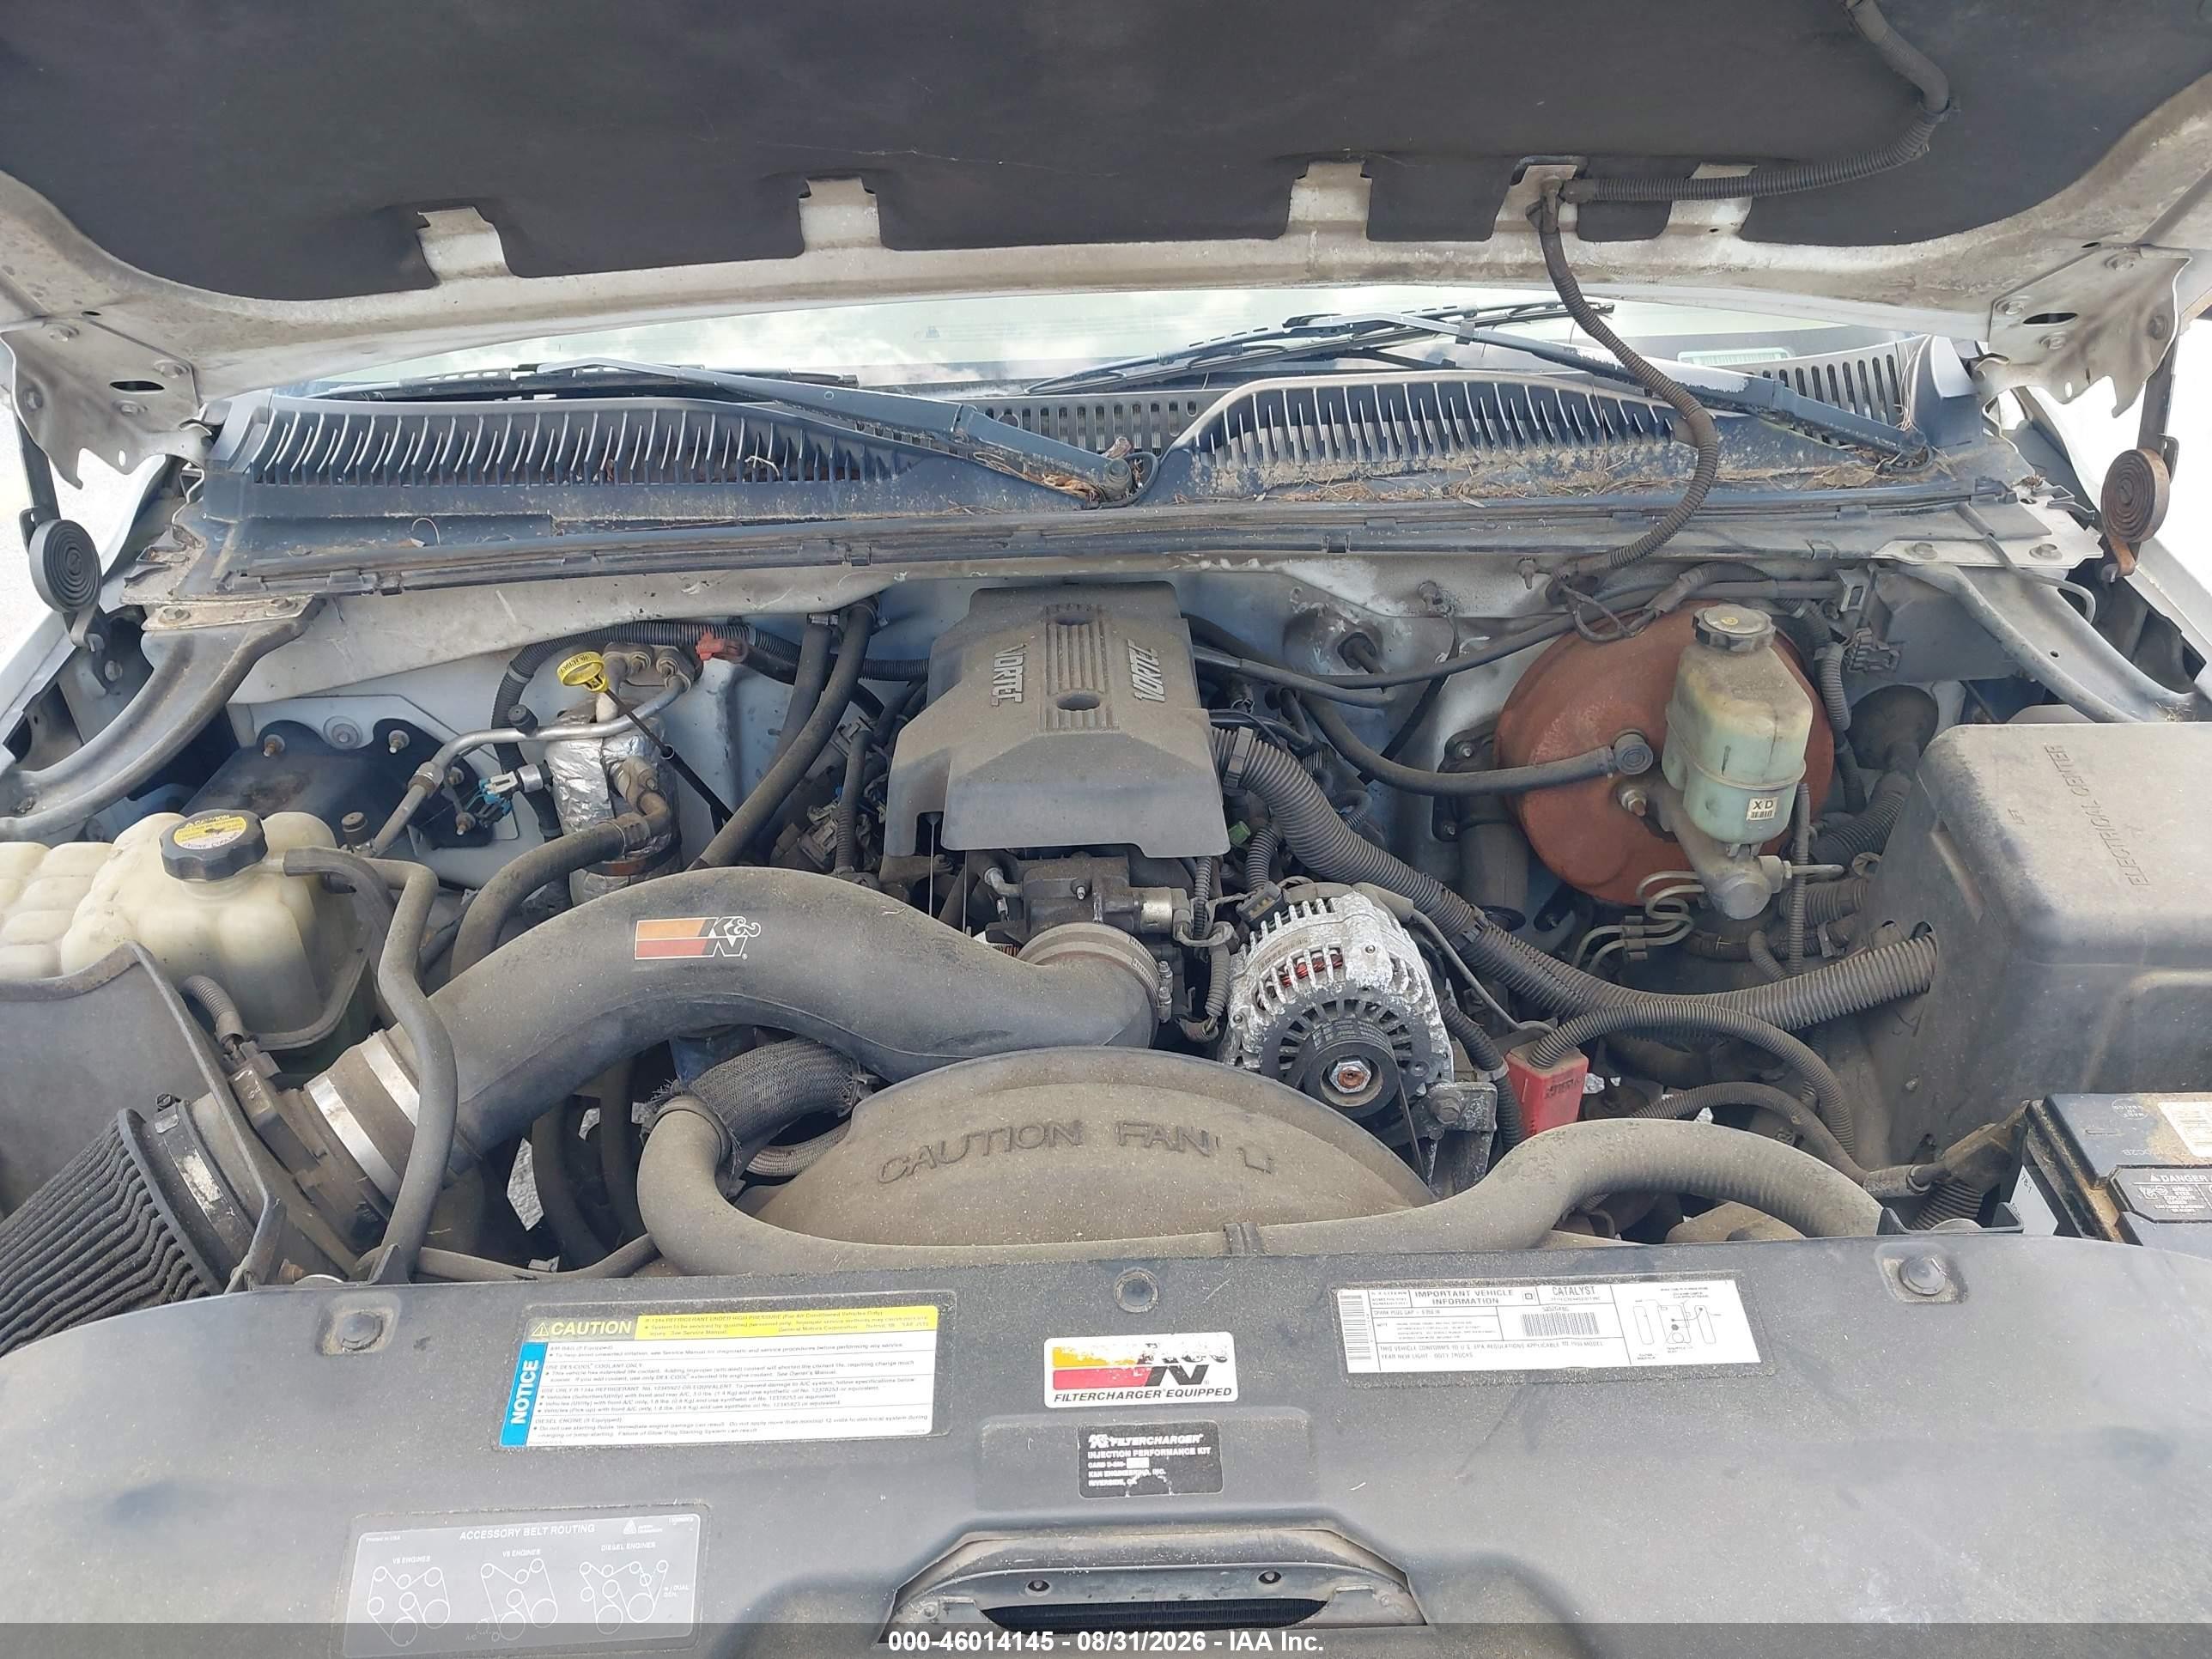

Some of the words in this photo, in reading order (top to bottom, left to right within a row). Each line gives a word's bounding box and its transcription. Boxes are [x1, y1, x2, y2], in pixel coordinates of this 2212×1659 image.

[878, 1119, 1082, 1185] CAUTION
[1117, 1120, 1211, 1158] FAN
[1551, 1285, 1595, 1296] CATALYST
[1431, 1297, 1499, 1305] INFORMATION
[550, 1321, 633, 1337] CAUTION
[510, 1359, 539, 1425] NOTICE
[1054, 1389, 1162, 1403] FILTERCHARGER
[1166, 1388, 1232, 1398] EQUIPPED
[1087, 1449, 1132, 1458] INJECTION
[1133, 1448, 1196, 1457] PERFORMANCE
[1197, 1446, 1212, 1455] KIT
[459, 1528, 520, 1540] ACCESSORY
[523, 1526, 549, 1536] BELT
[550, 1523, 595, 1534] ROUTING
[626, 1541, 656, 1550] ENGINES
[511, 1548, 540, 1557] ENGINES
